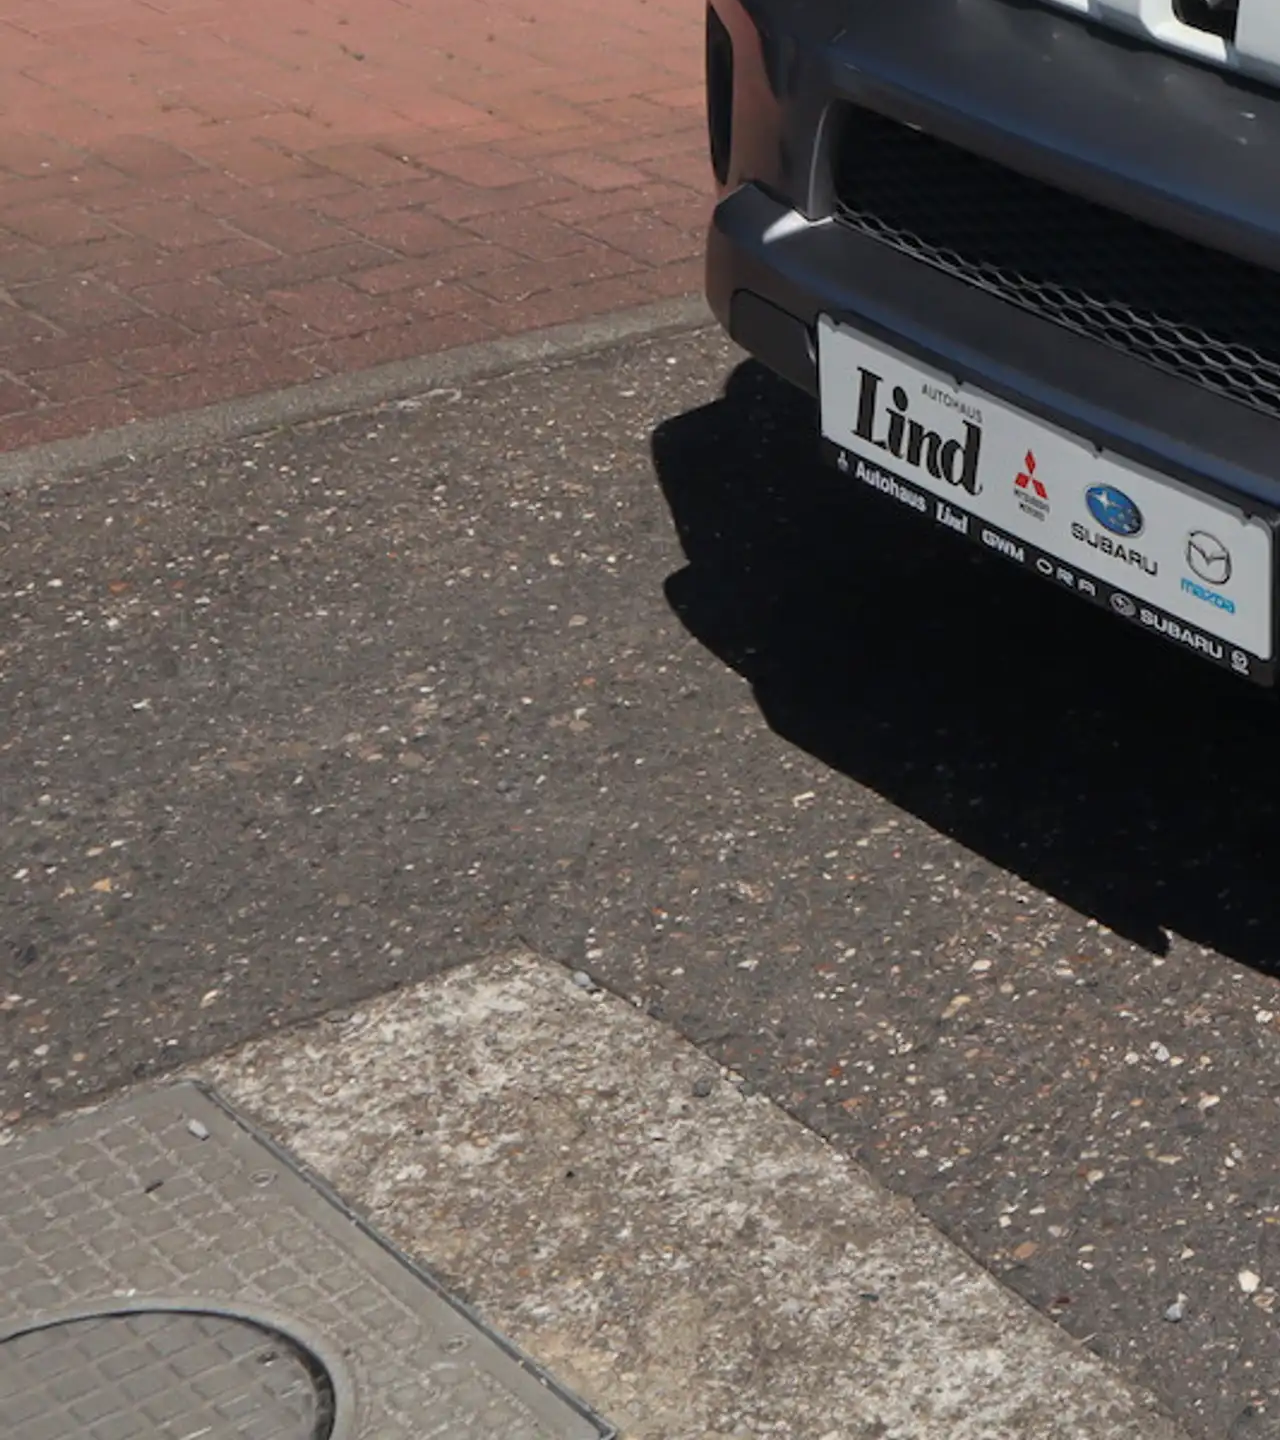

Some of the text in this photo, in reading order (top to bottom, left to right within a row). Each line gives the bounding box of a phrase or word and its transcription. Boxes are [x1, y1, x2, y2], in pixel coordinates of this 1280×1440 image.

[850, 366, 984, 496] Lind
[921, 383, 984, 423] AUTOHAUS
[855, 461, 927, 512] Autohaus
[936, 502, 969, 535] Lind
[1139, 609, 1223, 660] SUBARU
[1070, 521, 1159, 578] SUBARU
